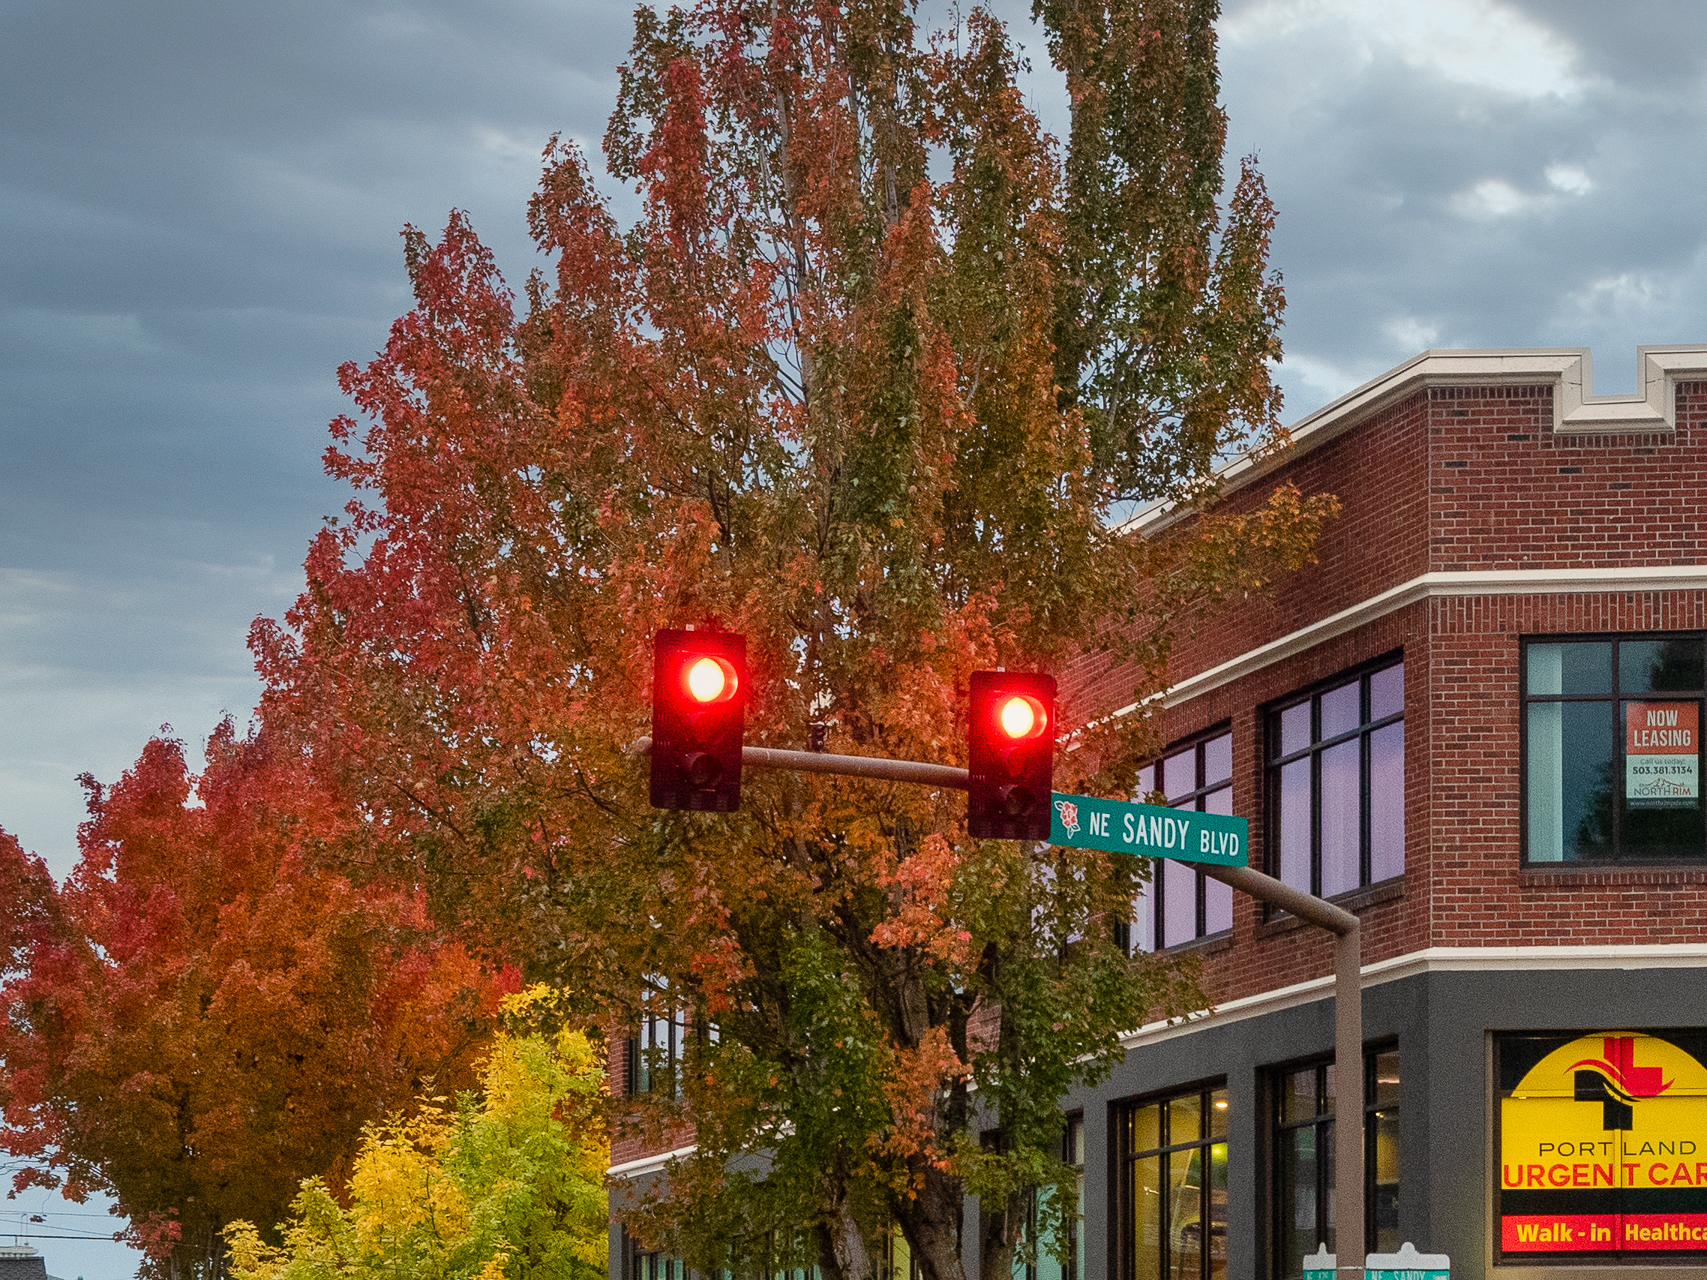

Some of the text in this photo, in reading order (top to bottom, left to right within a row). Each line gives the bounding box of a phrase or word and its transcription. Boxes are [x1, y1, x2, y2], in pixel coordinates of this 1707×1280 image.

[1646, 710, 1678, 726] NOW
[1633, 729, 1692, 747] LEASING
[1632, 766, 1693, 775] 503.381.3134
[1633, 787, 1692, 796] NORTH RIM
[1089, 811, 1239, 856] NE SANDY BLVD
[1539, 1140, 1698, 1158] PORTLAND
[1503, 1162, 1641, 1188] URGENT
